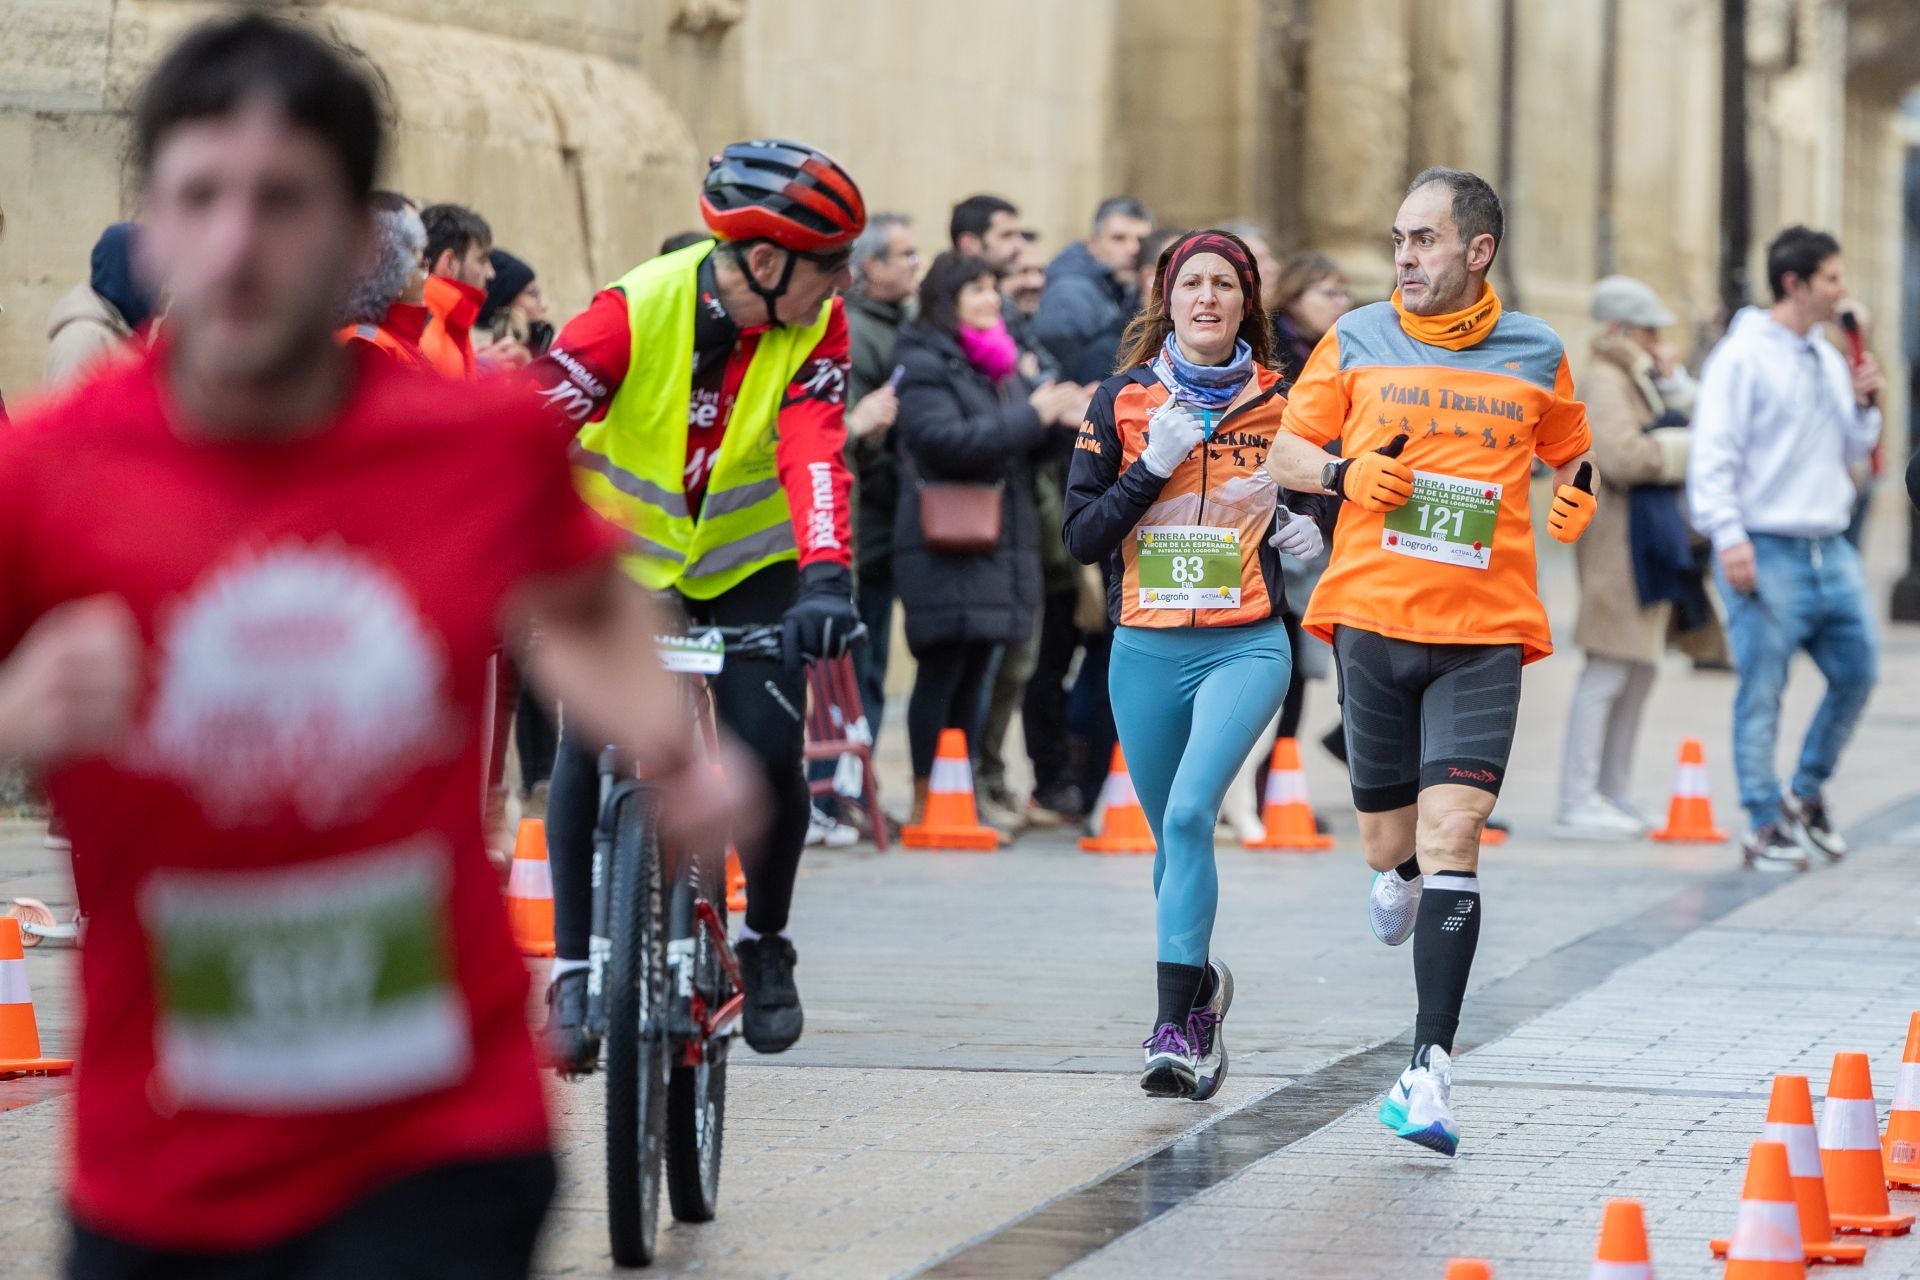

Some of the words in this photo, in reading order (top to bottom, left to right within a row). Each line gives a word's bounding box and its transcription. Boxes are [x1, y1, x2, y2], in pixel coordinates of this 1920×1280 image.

[1380, 383, 1430, 407] VIANA
[1439, 388, 1524, 423] TREKKING
[1209, 431, 1269, 450] REKKING
[1411, 478, 1446, 491] RRERA
[1449, 484, 1498, 500] POPULR
[1439, 491, 1449, 499] LA
[1451, 493, 1495, 507] ESPERANZA
[1417, 503, 1465, 537] 121
[1141, 532, 1185, 541] CRRERA
[1189, 533, 1236, 542] POPULR
[1144, 541, 1167, 549] VIRGEN
[1193, 542, 1235, 550] ESPERANZA
[1400, 538, 1438, 553] Logroño
[1451, 549, 1473, 557] ACTUAL
[1171, 556, 1204, 583] 83
[1156, 592, 1189, 602] Logroño
